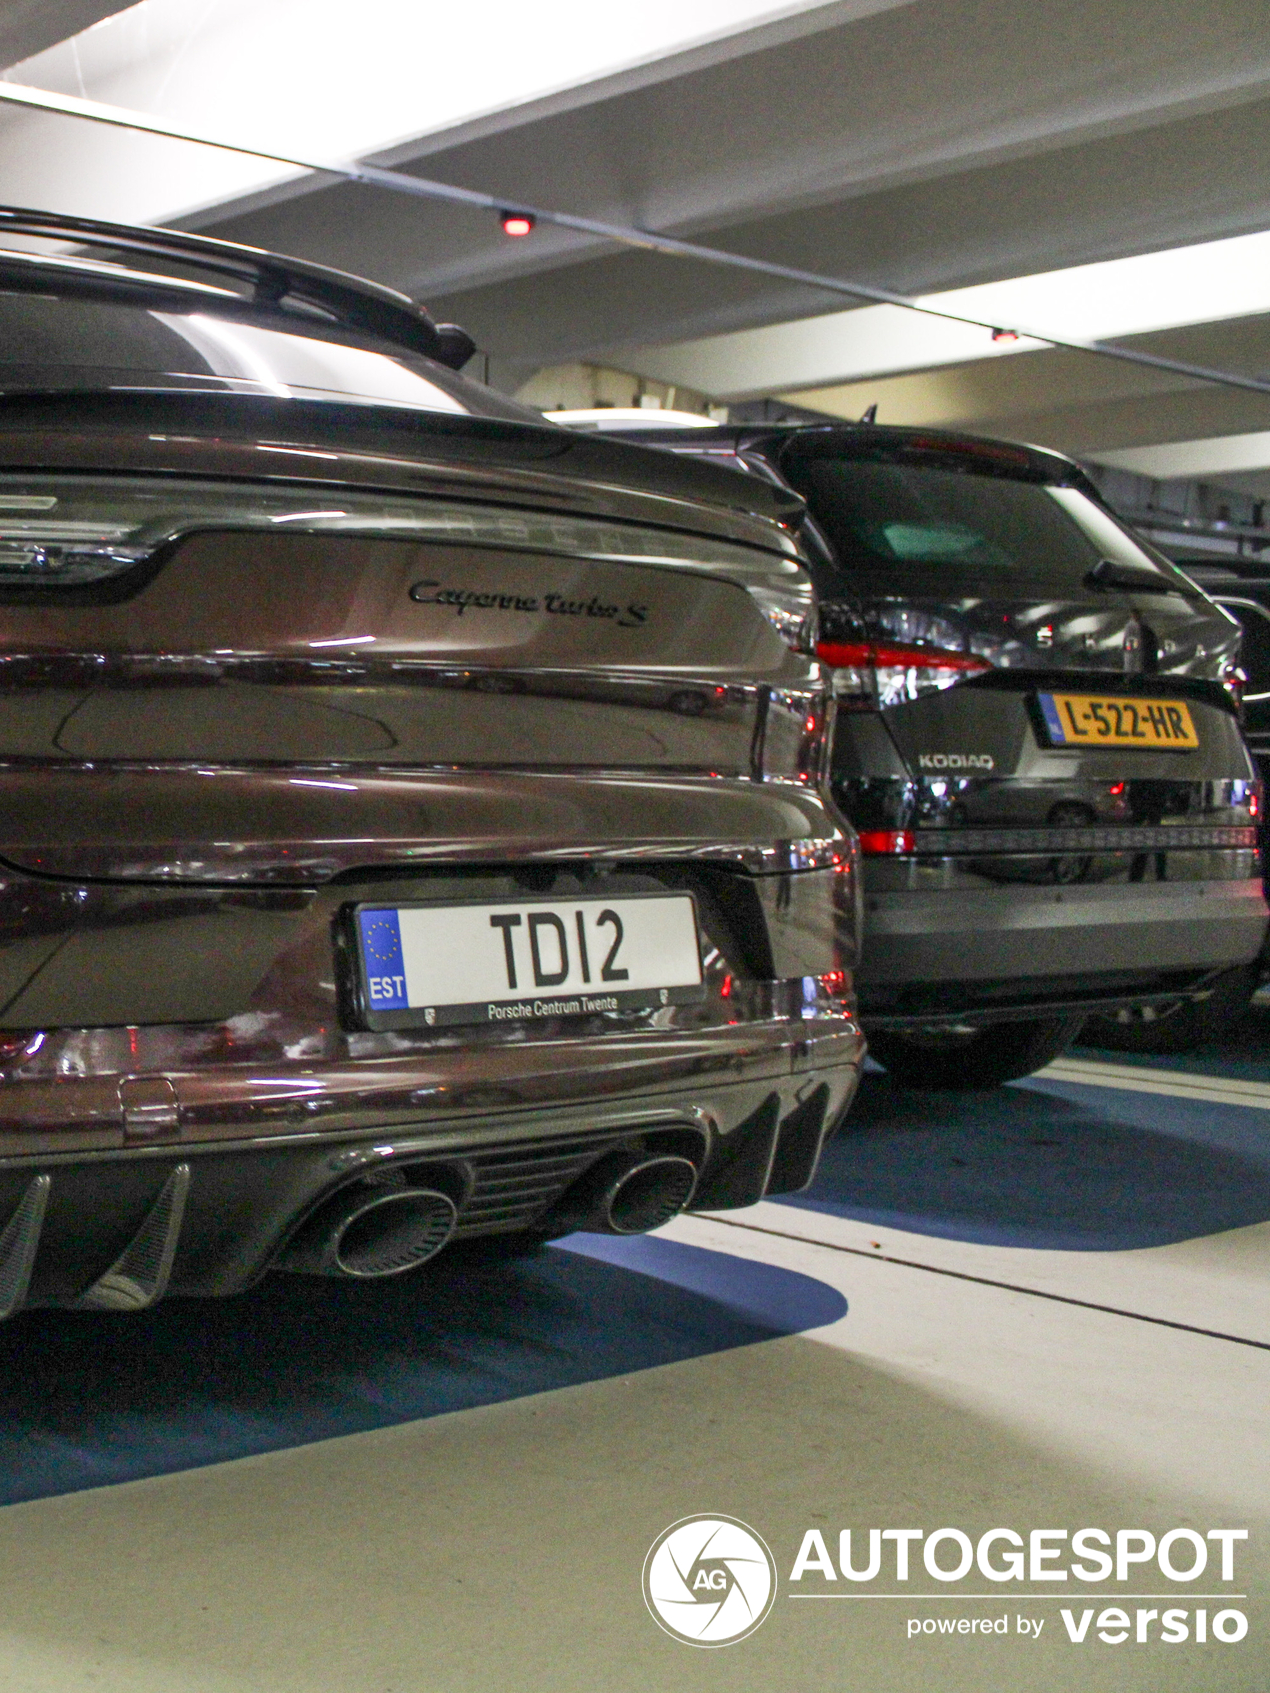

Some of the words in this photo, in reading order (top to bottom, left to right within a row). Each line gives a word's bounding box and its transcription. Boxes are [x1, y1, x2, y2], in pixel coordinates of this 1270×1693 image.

[408, 579, 540, 616] Cayenne
[1064, 699, 1190, 740] L-522-HR
[919, 754, 994, 771] KODIAQ
[370, 976, 404, 999] EST
[488, 1002, 532, 1019] Porsche
[533, 999, 580, 1016] Centrum
[580, 996, 618, 1012] Twente
